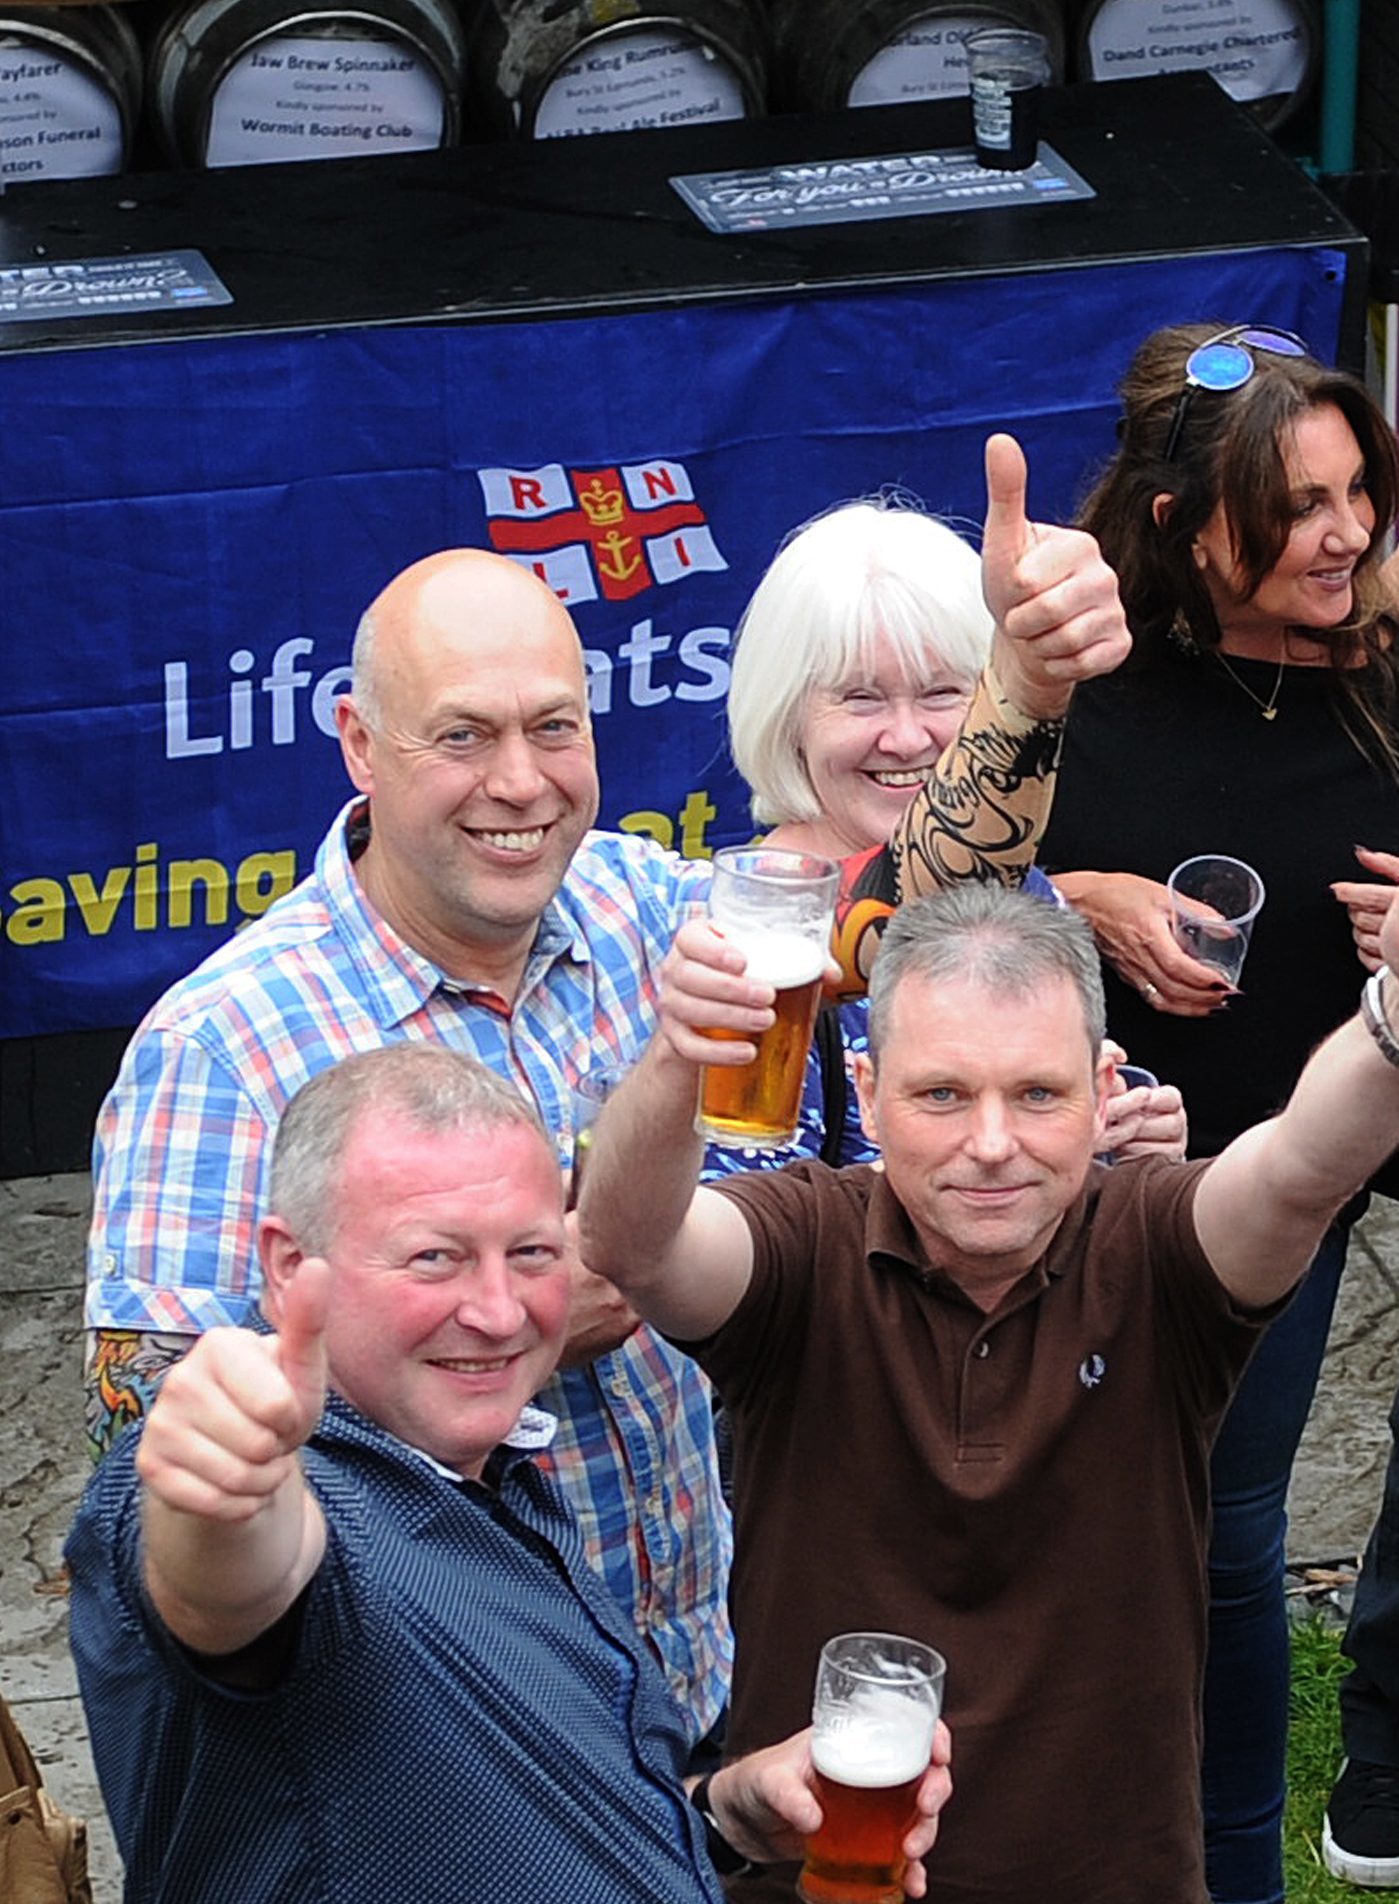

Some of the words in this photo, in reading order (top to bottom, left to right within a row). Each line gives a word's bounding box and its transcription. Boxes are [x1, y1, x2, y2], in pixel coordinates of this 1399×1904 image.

[1102, 47, 1147, 62] Dand
[1150, 41, 1219, 57] Carnegie
[250, 53, 283, 69] Jaw
[286, 55, 331, 71] Brew
[334, 56, 416, 74] Spinnaker
[586, 52, 623, 73] King
[659, 97, 721, 123] Festival
[0, 135, 33, 149] son
[37, 126, 101, 145] Funeral
[240, 119, 305, 135] Wormit
[309, 121, 372, 140] Boating
[375, 123, 414, 138] Club
[0, 842, 297, 946] aving
